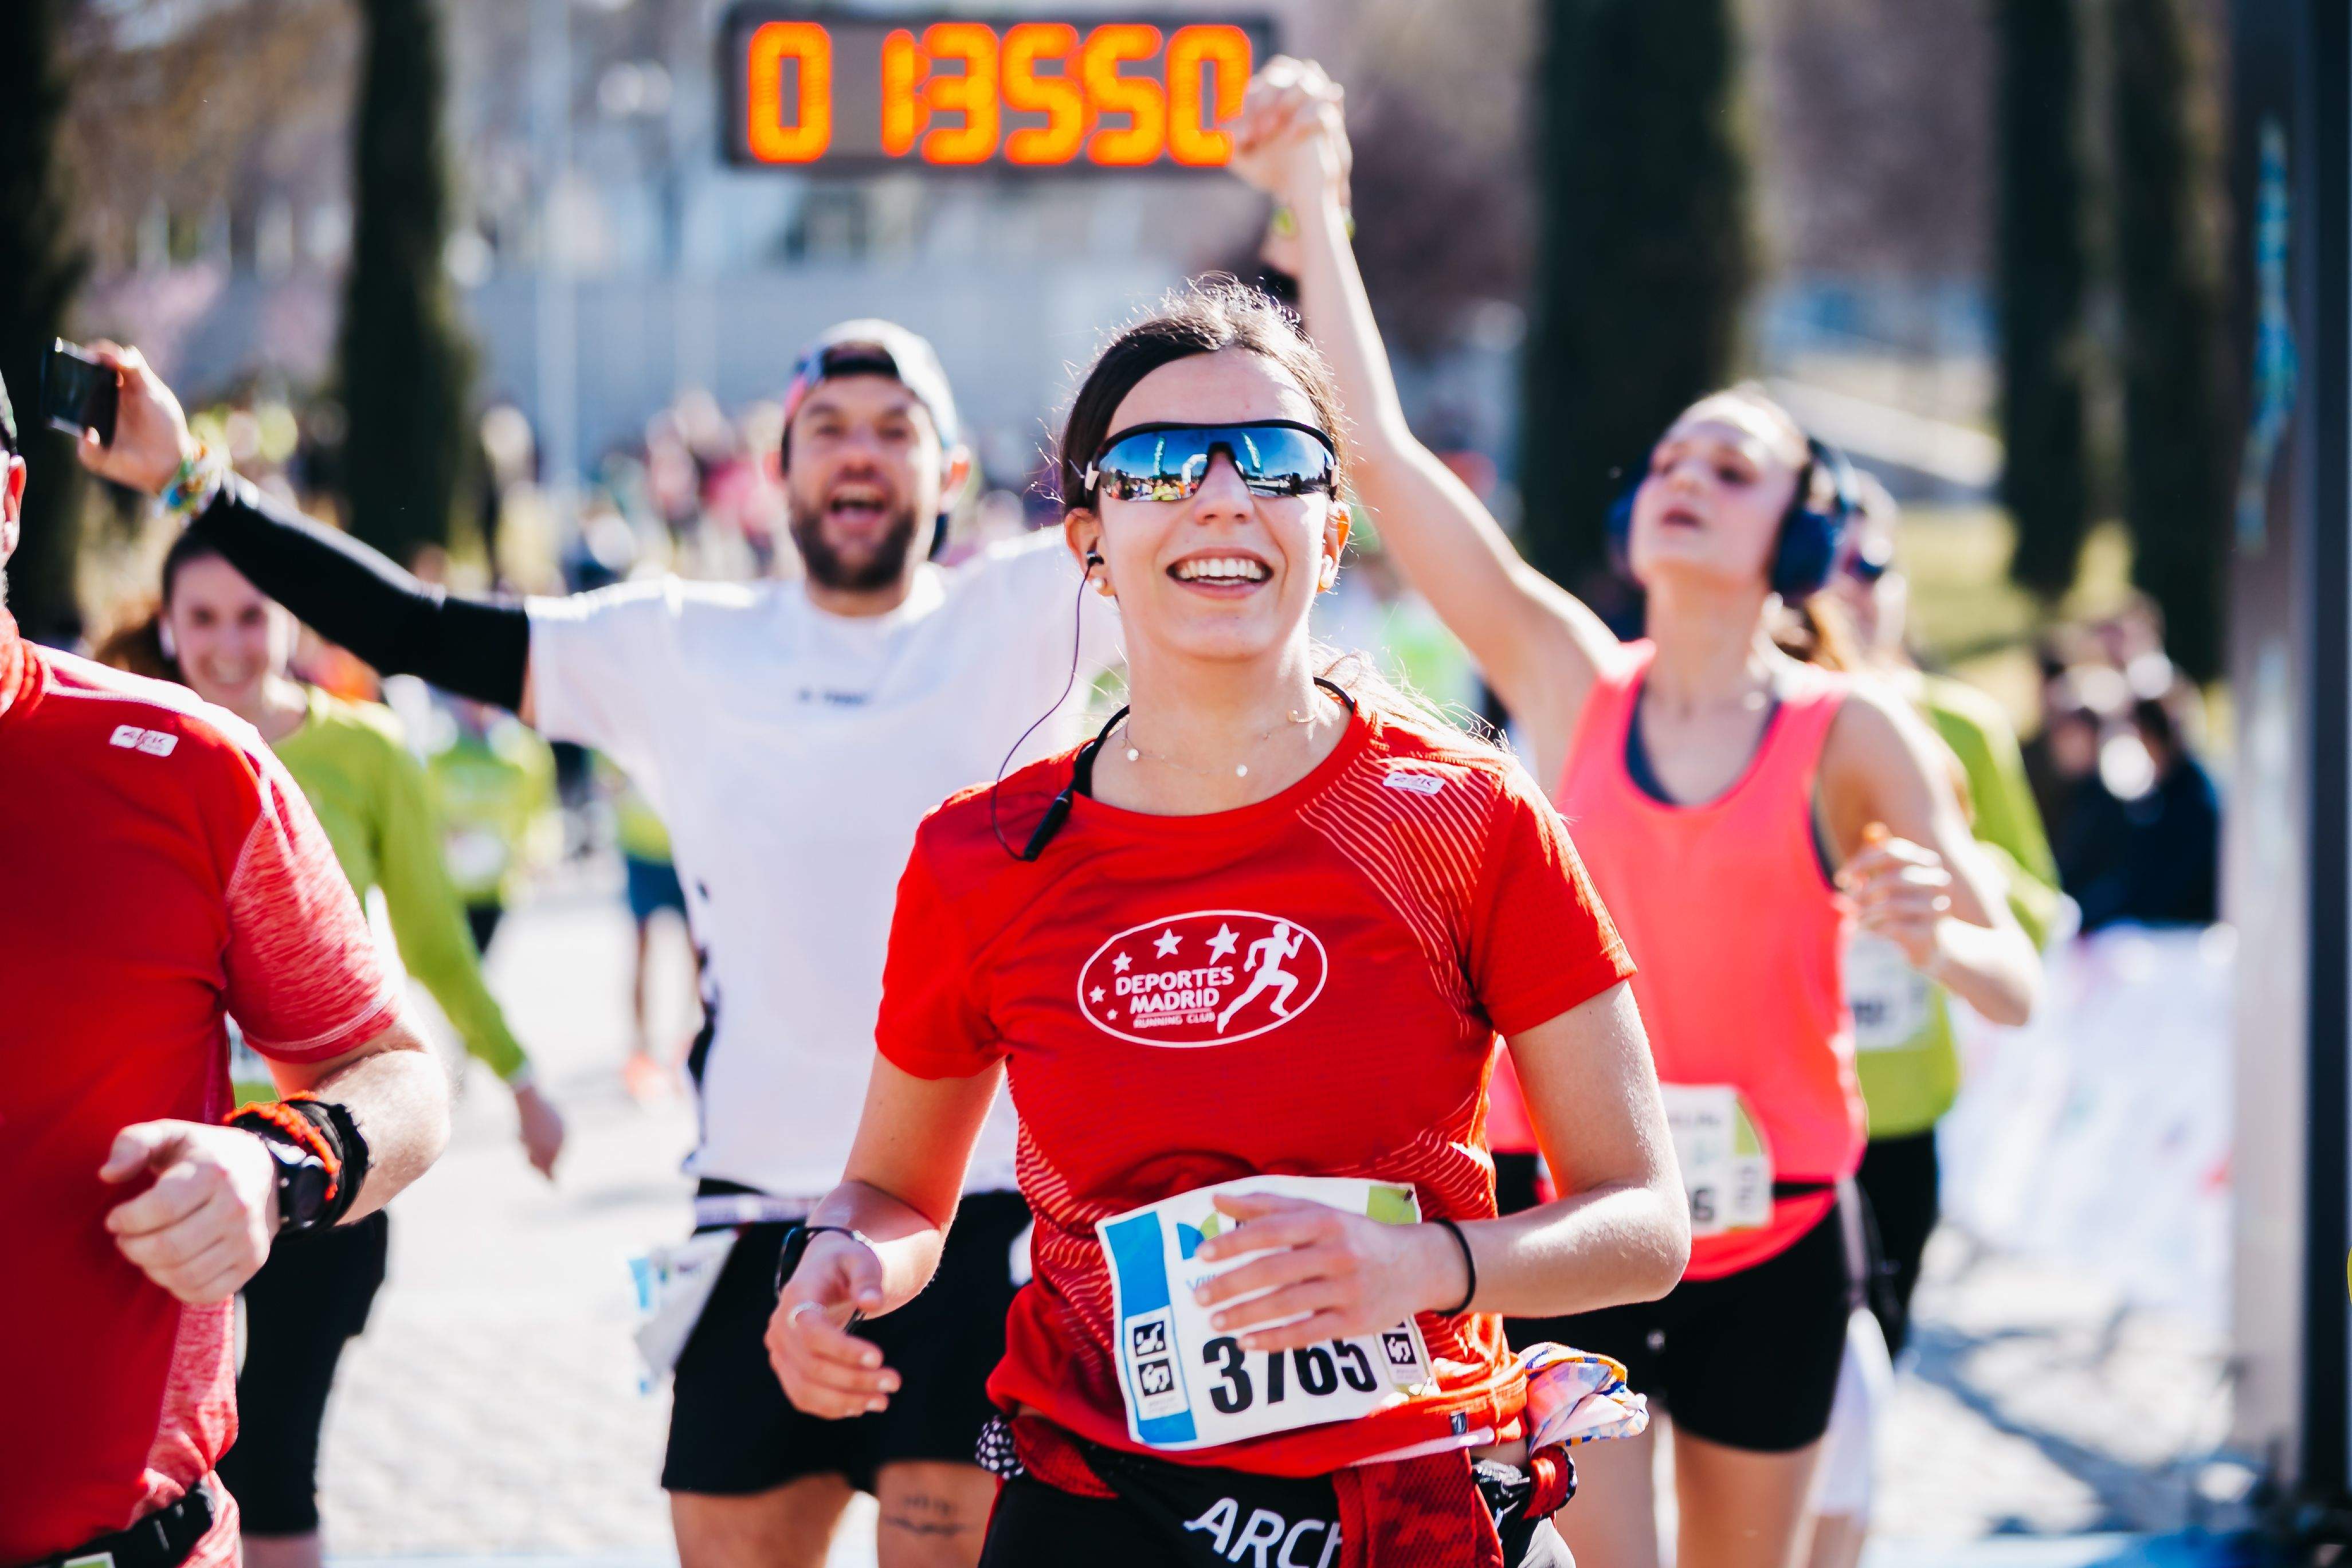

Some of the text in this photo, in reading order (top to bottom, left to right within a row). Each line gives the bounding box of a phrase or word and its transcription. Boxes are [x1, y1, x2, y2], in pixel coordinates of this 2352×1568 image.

[1115, 966, 1234, 996] DEPORTES
[1129, 987, 1220, 1015] MADRID
[1133, 1011, 1216, 1029] RUNNING CLUB
